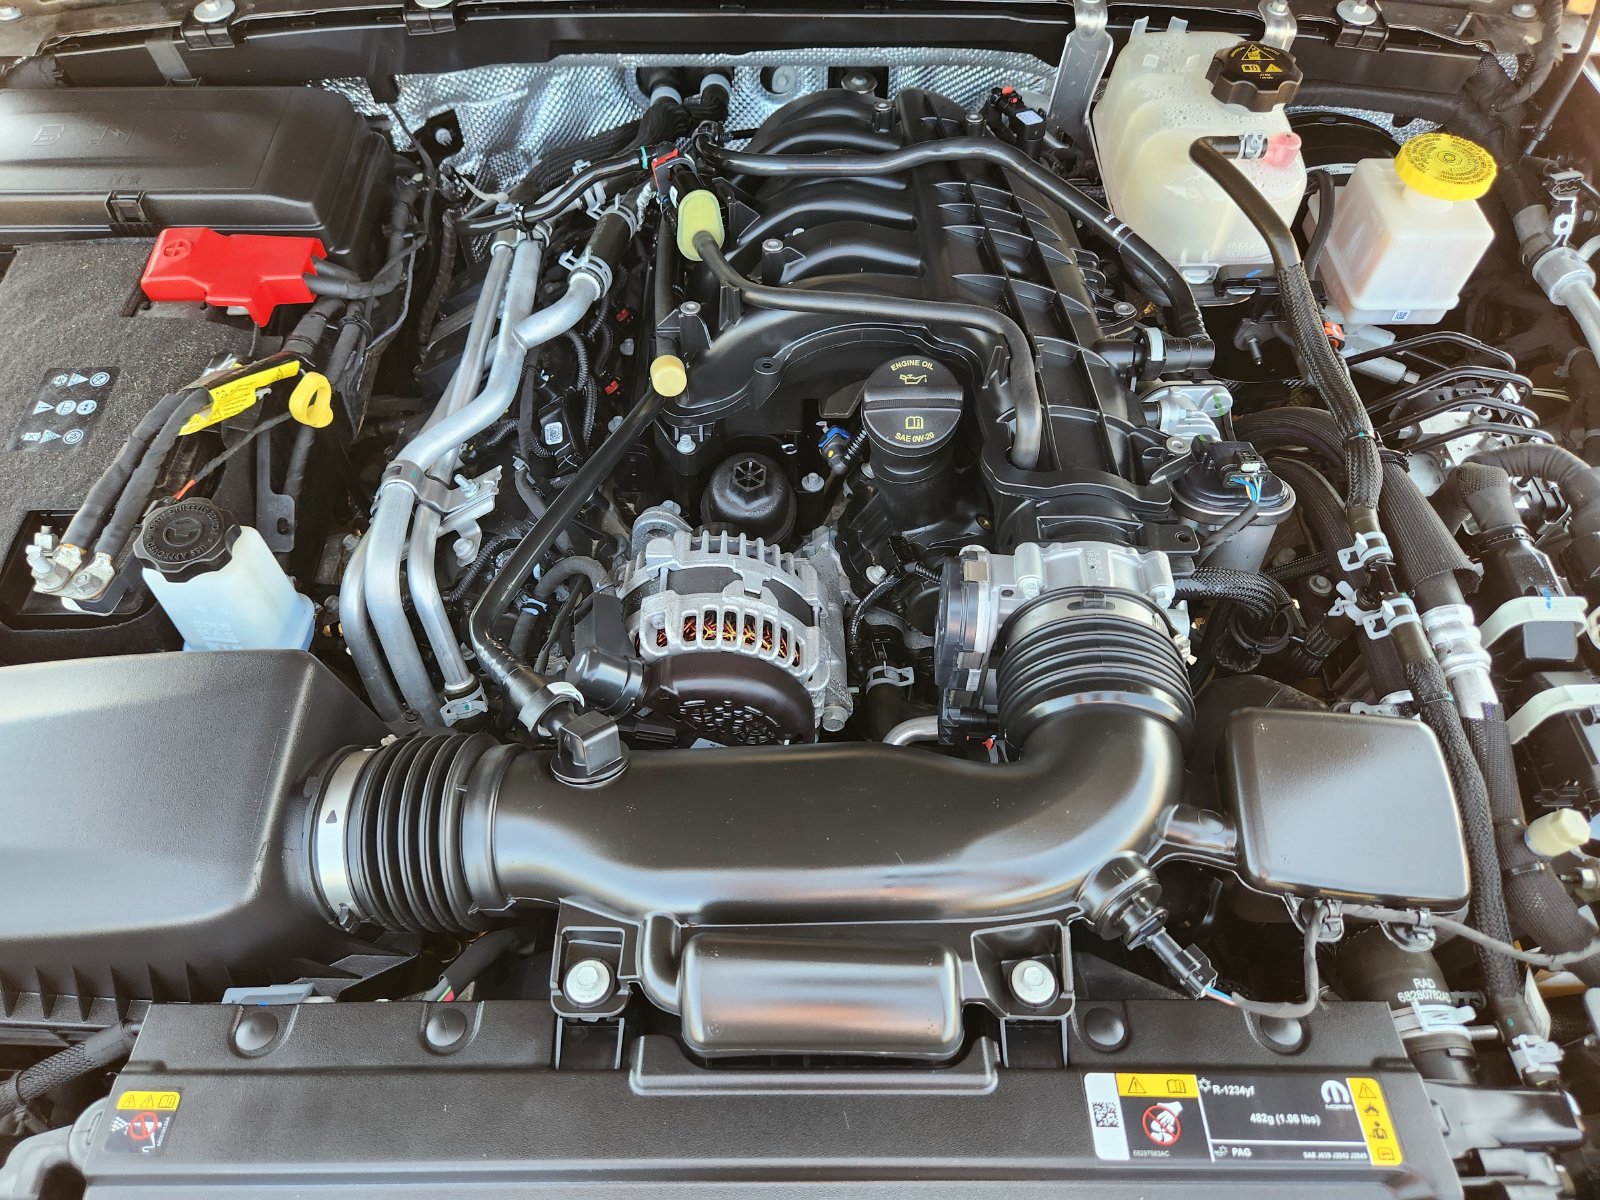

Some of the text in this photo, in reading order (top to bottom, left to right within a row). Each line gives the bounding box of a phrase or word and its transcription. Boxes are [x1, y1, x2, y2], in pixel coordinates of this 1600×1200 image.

[890, 359, 934, 372] ENGINE OIL
[895, 431, 935, 443] SAE 0W-20
[168, 504, 208, 515] STEERING
[146, 541, 187, 560] APPROVED
[1412, 977, 1436, 989] RAD
[1212, 1084, 1256, 1098] R-1234yf
[1250, 1112, 1321, 1127] 482g (1.06 lbs)
[1231, 1147, 1253, 1158] PAG
